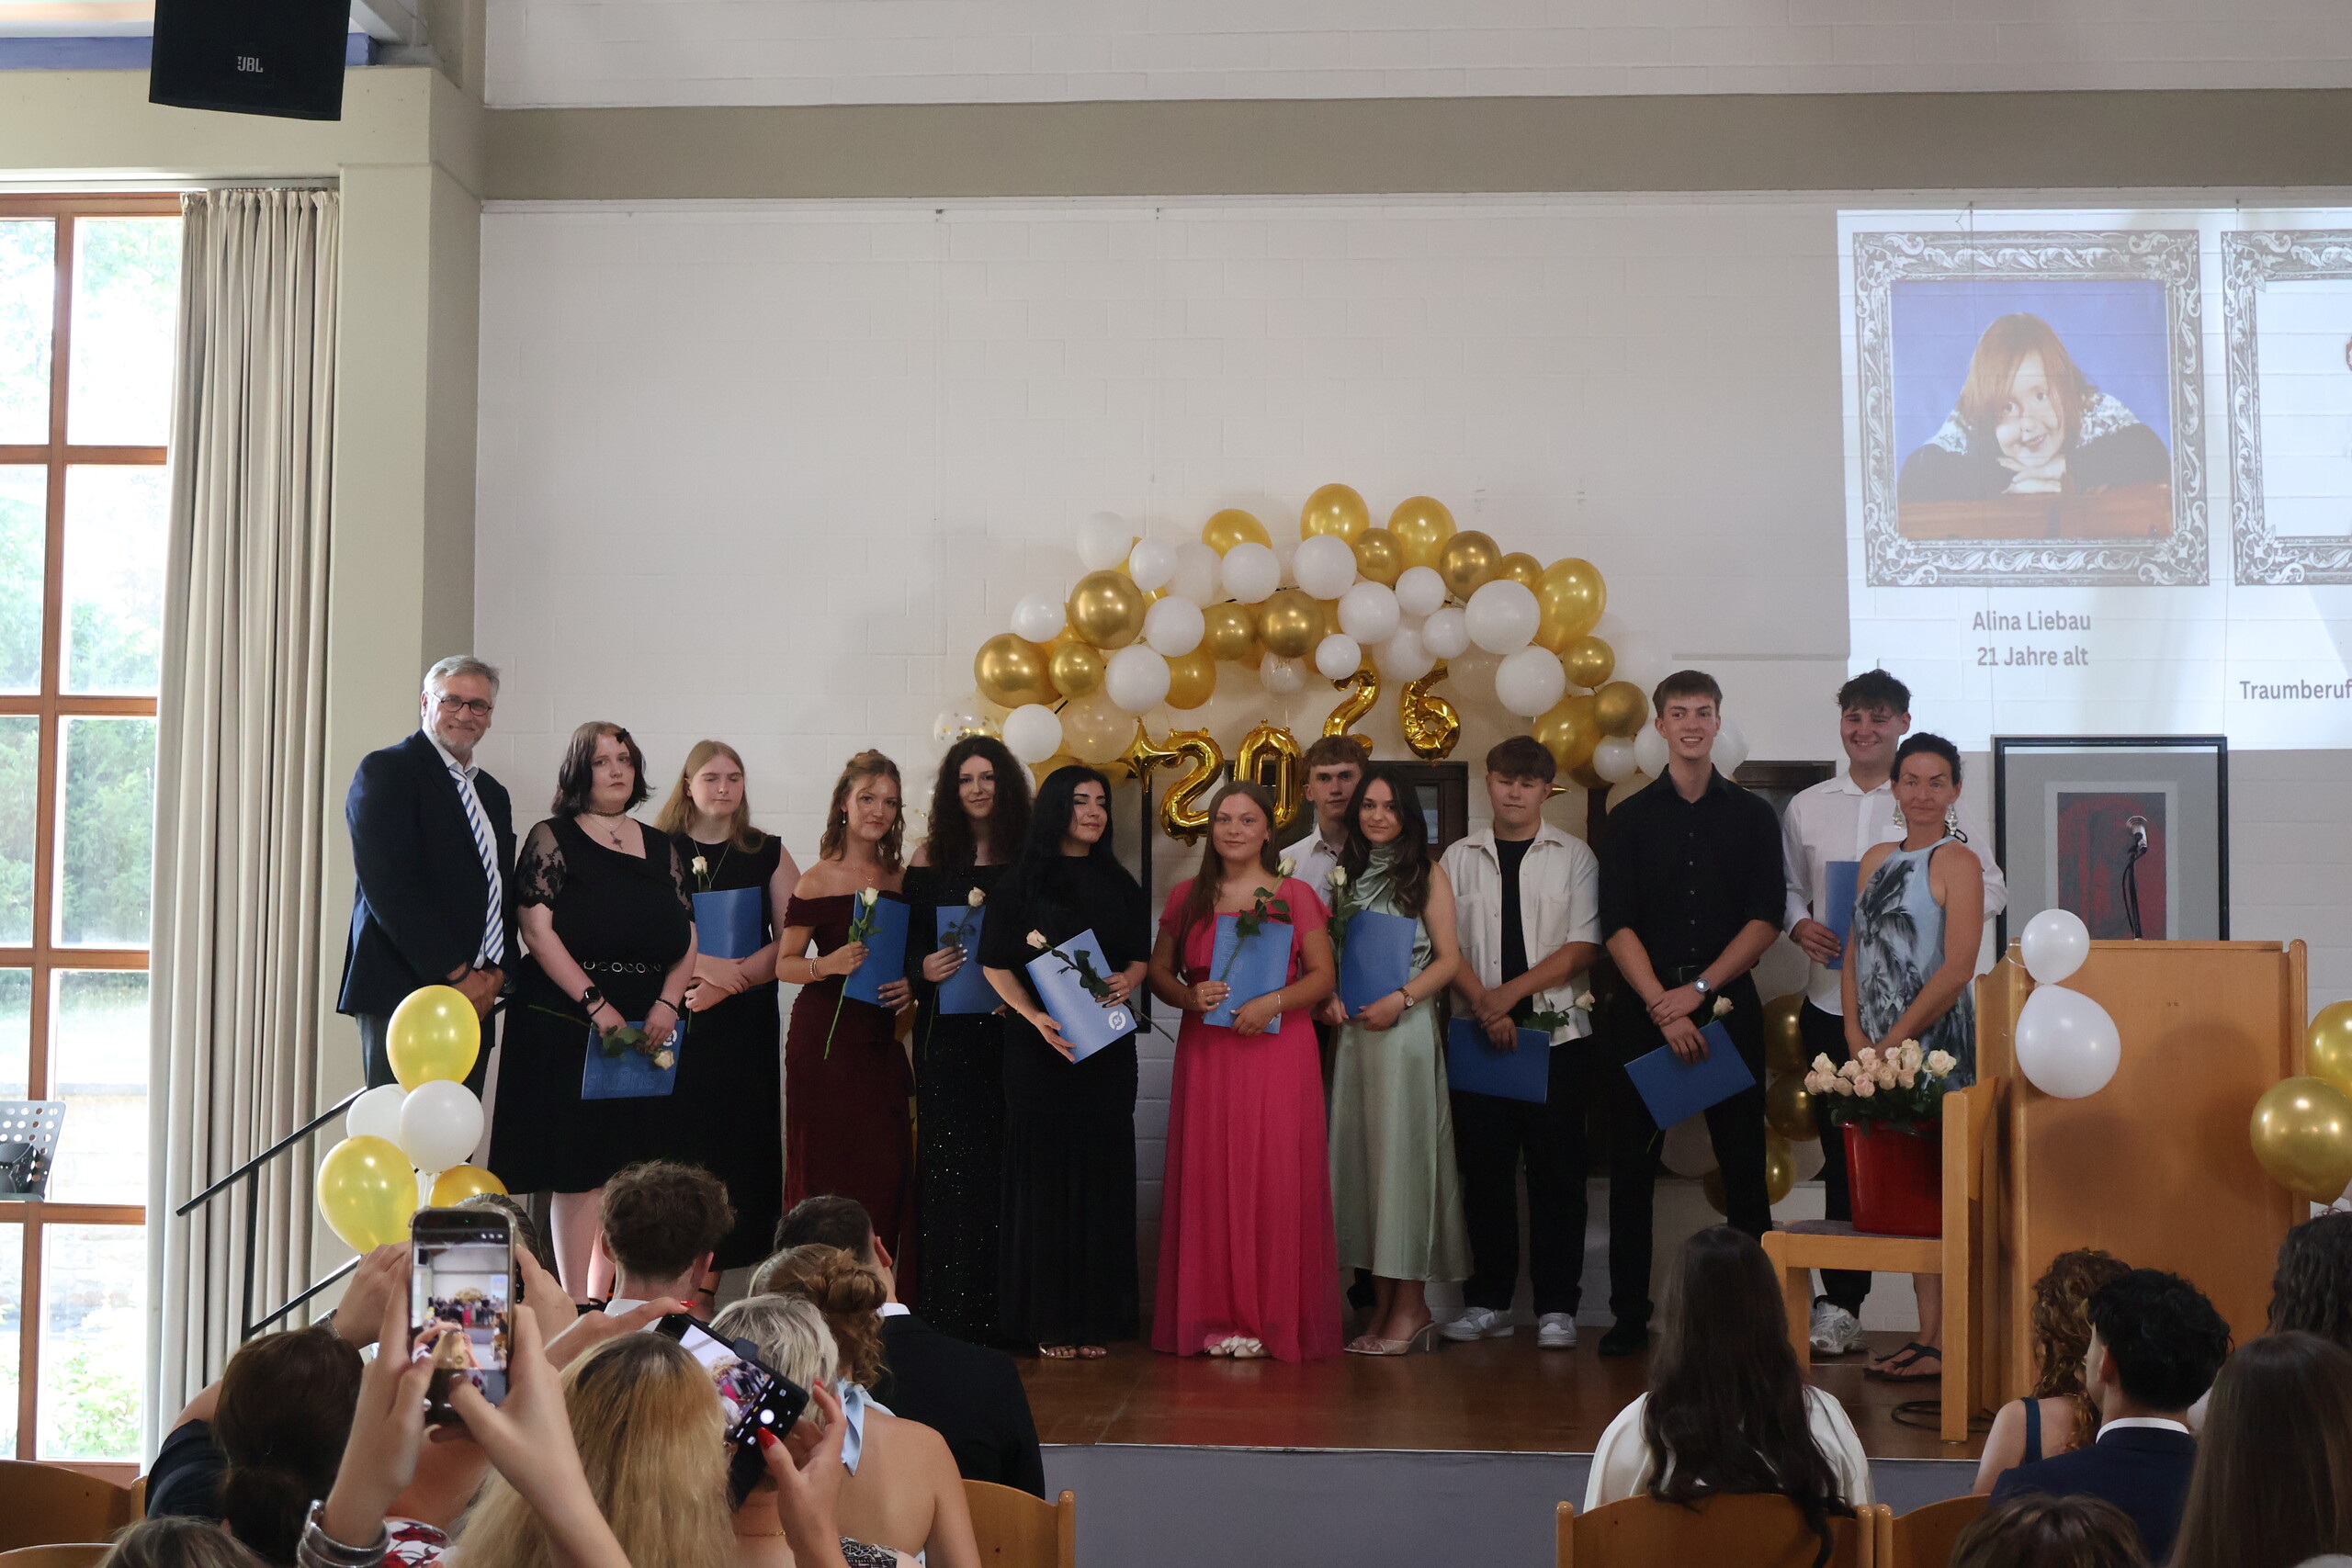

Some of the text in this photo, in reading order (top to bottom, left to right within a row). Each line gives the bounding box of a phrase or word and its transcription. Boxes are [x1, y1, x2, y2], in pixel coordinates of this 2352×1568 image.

[237, 55, 264, 73] JBL
[1973, 610, 2091, 631] Alina Liebau
[1977, 645, 2089, 666] 21 Jahre alt
[2239, 679, 2352, 700] Traumberuf
